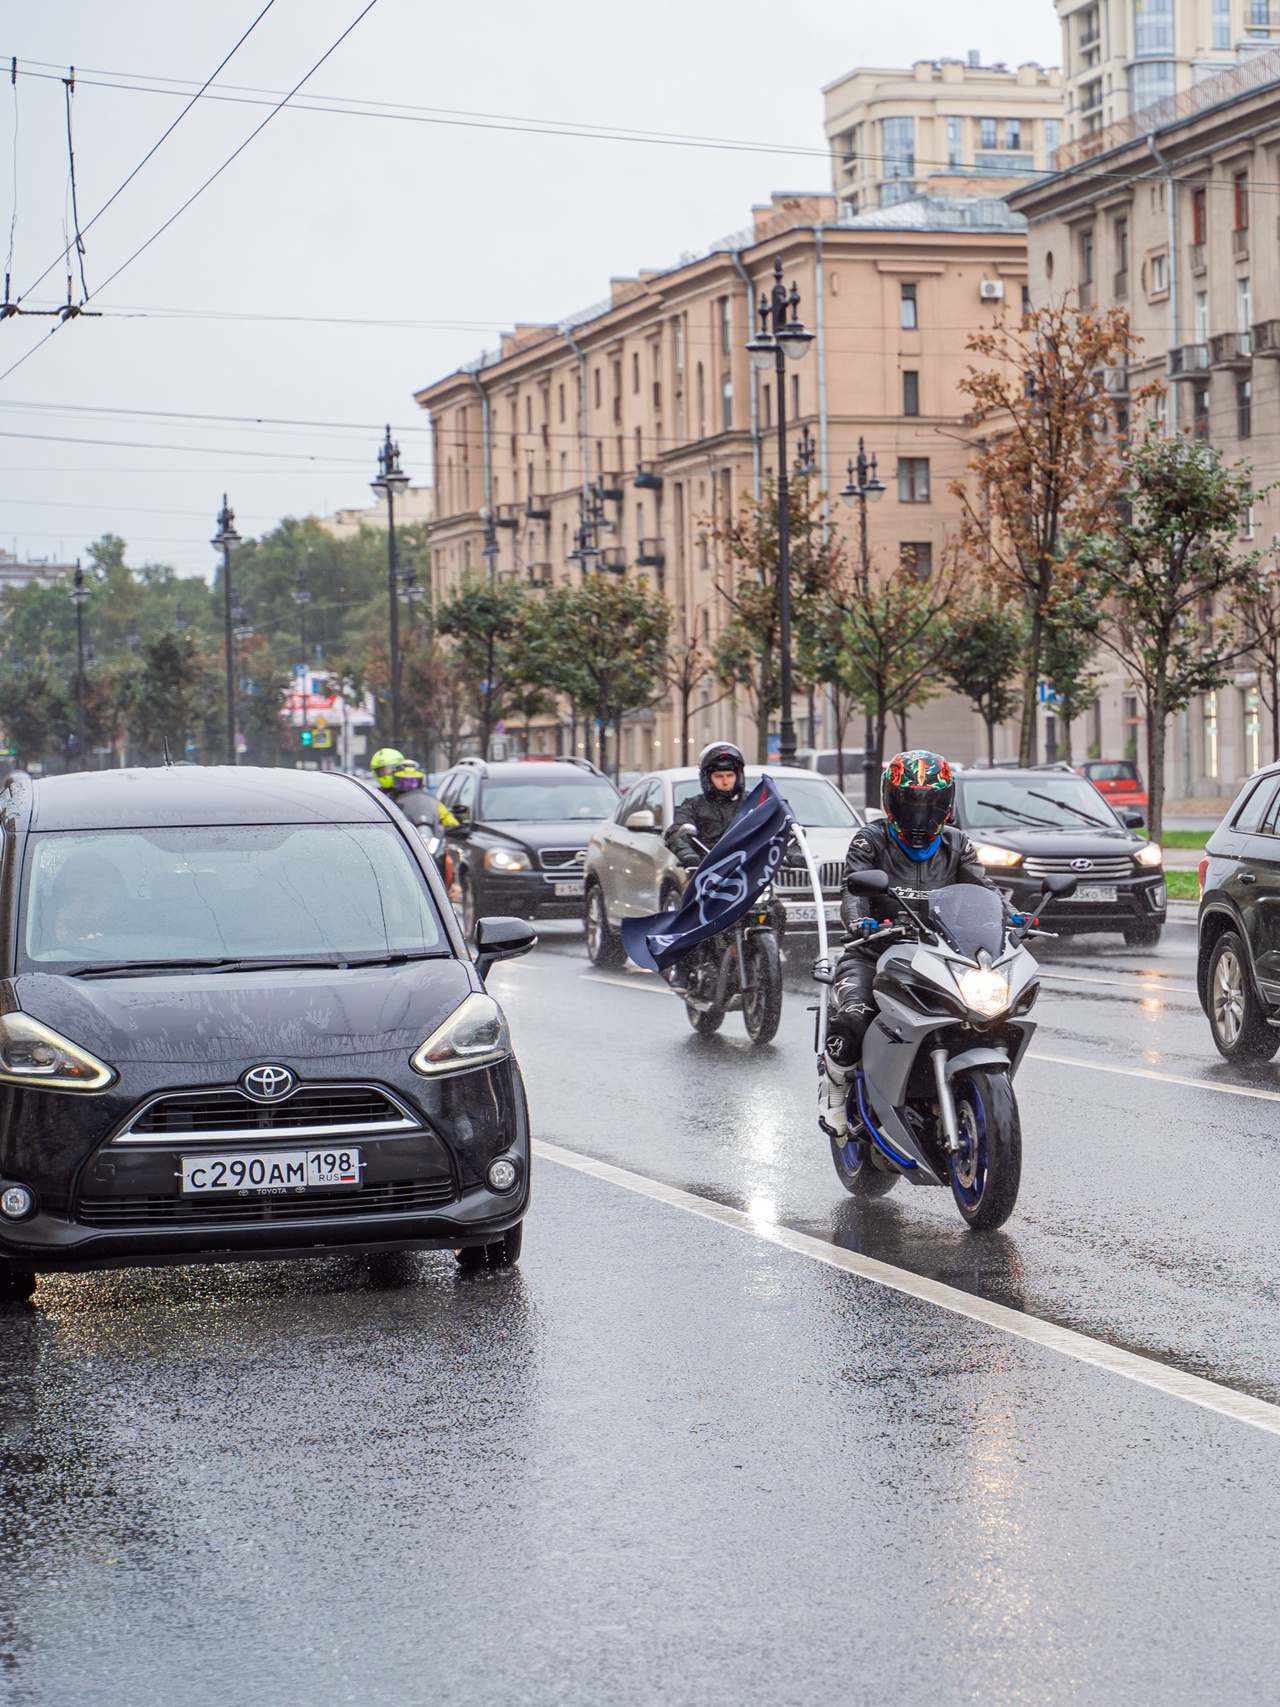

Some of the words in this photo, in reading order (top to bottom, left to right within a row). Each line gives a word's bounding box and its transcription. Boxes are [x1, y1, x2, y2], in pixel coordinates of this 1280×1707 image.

[787, 908, 831, 920] О562Е
[190, 1159, 305, 1188] С290АМ
[310, 1153, 351, 1173] 198
[319, 1173, 339, 1182] RUS
[256, 1187, 287, 1195] TOYOTA
